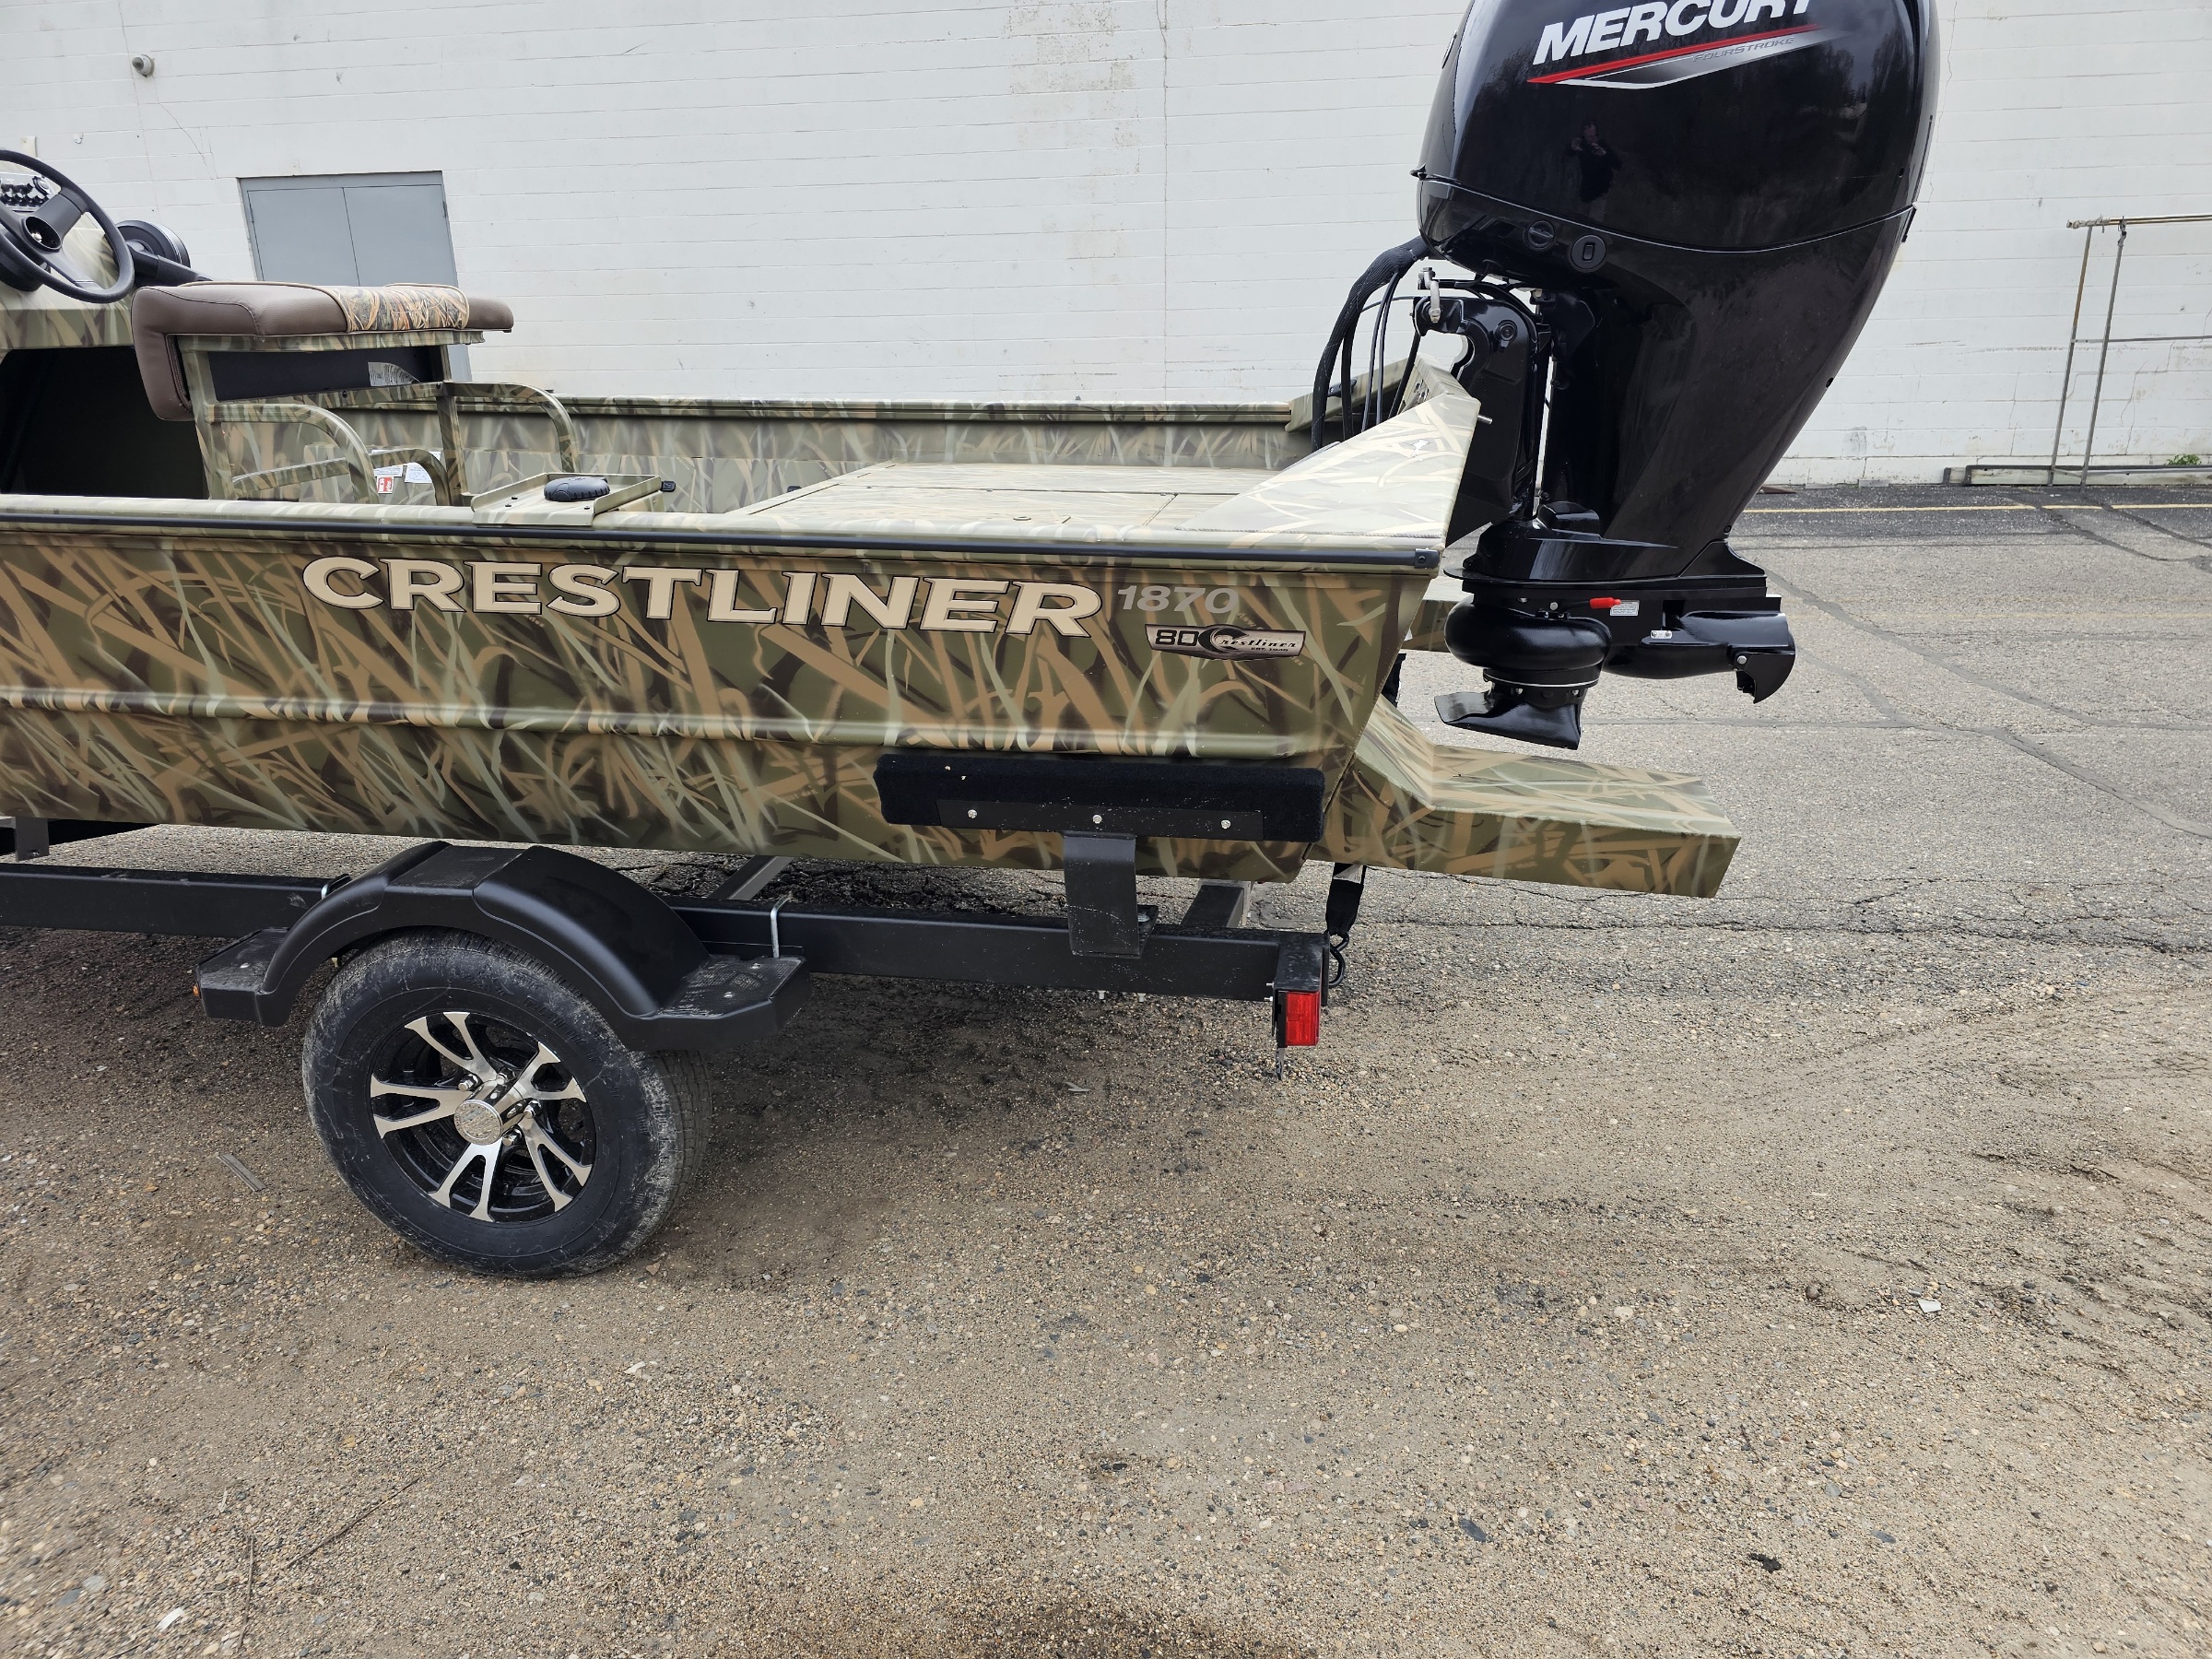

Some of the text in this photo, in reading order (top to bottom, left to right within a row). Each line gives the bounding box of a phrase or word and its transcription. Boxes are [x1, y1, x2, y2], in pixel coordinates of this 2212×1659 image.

[1691, 36, 1795, 63] FOURSTROKE
[301, 556, 1102, 638] CRESTLINER
[1117, 585, 1239, 614] 1870
